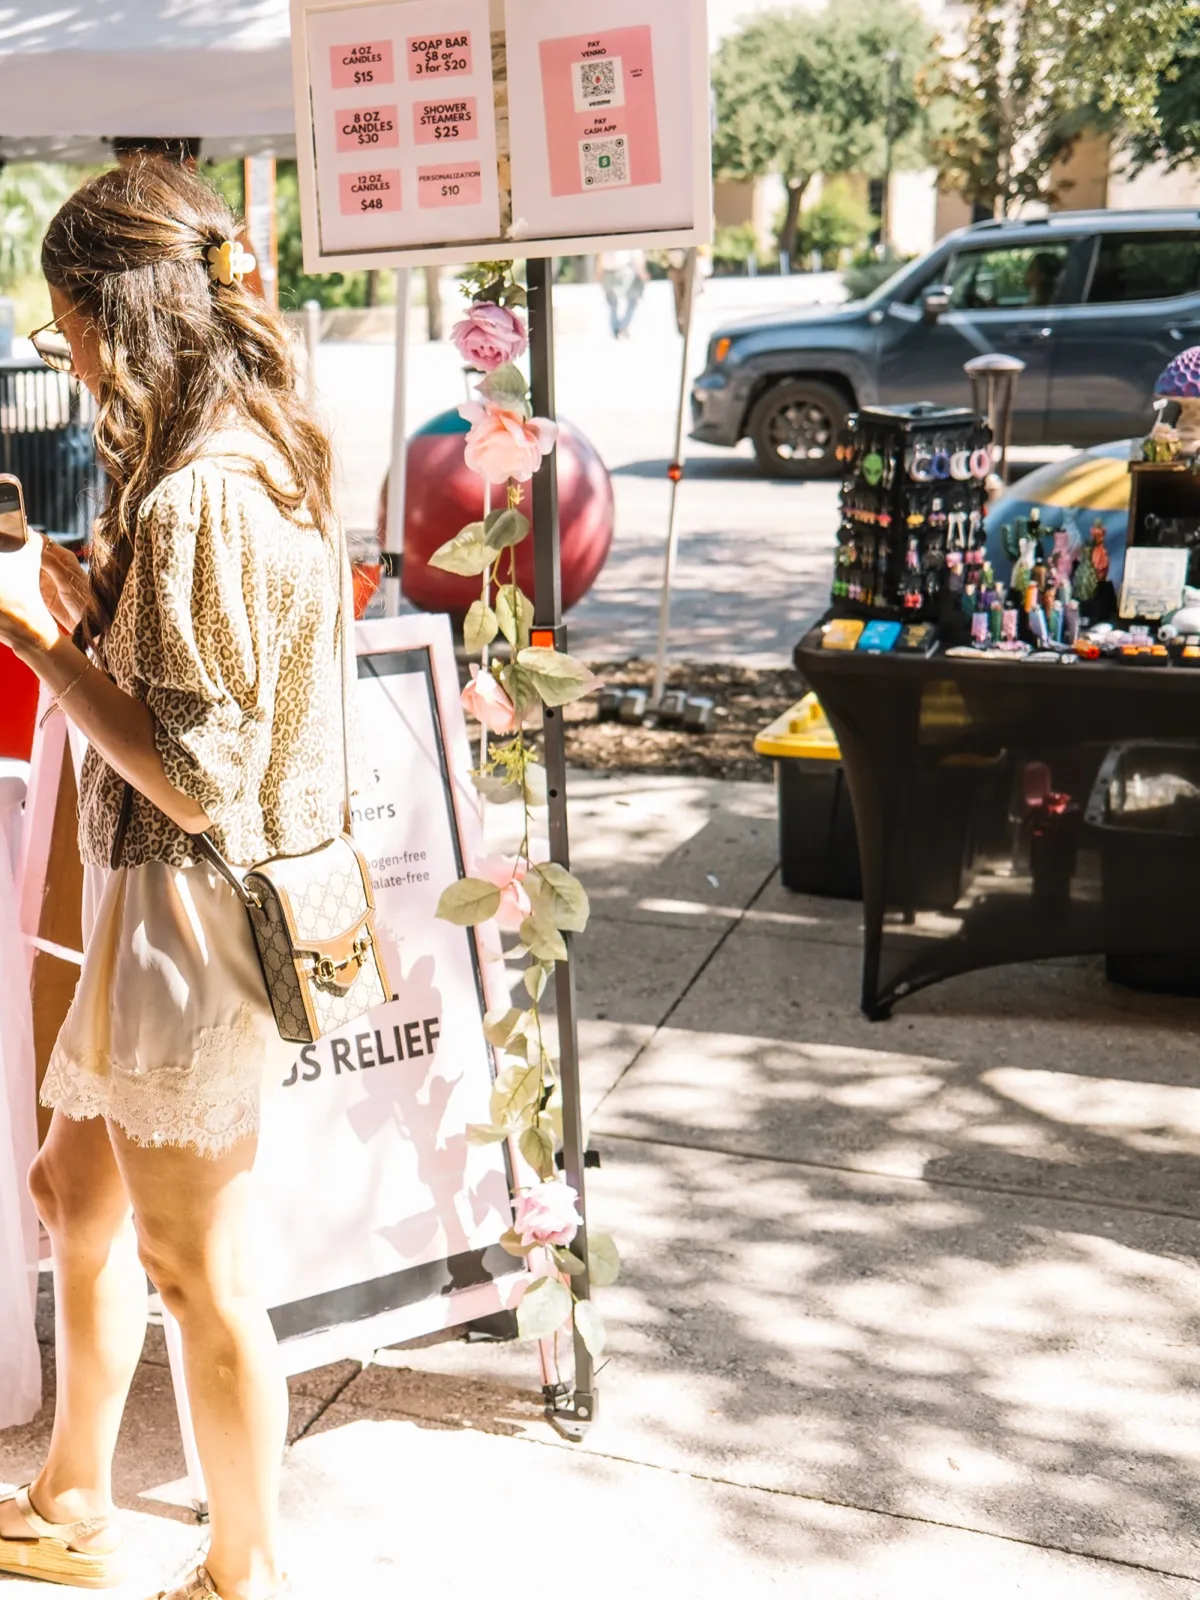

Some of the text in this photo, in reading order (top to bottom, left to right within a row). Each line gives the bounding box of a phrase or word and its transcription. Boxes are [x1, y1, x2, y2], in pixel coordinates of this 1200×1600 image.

[412, 36, 468, 52] SOAP BAR
[358, 46, 372, 54] OZ
[581, 49, 606, 58] VENMO
[342, 54, 382, 66] CANDLES
[425, 51, 453, 62] $8 or
[416, 59, 466, 74] 3 for $20
[354, 71, 373, 84] $15
[589, 99, 610, 107] venmo
[423, 103, 467, 115] SHOWER
[354, 112, 380, 122] 8 OZ
[420, 112, 472, 124] STEAMERS
[342, 121, 393, 135] CANDLES
[434, 126, 459, 138] $25
[584, 127, 602, 135] CASH
[358, 134, 379, 144] $30
[418, 171, 480, 182] PERSONALIZATION
[351, 182, 390, 193] CANDLES
[441, 185, 459, 196] $10
[361, 199, 382, 211] $48
[330, 1018, 440, 1075] RELIEF
